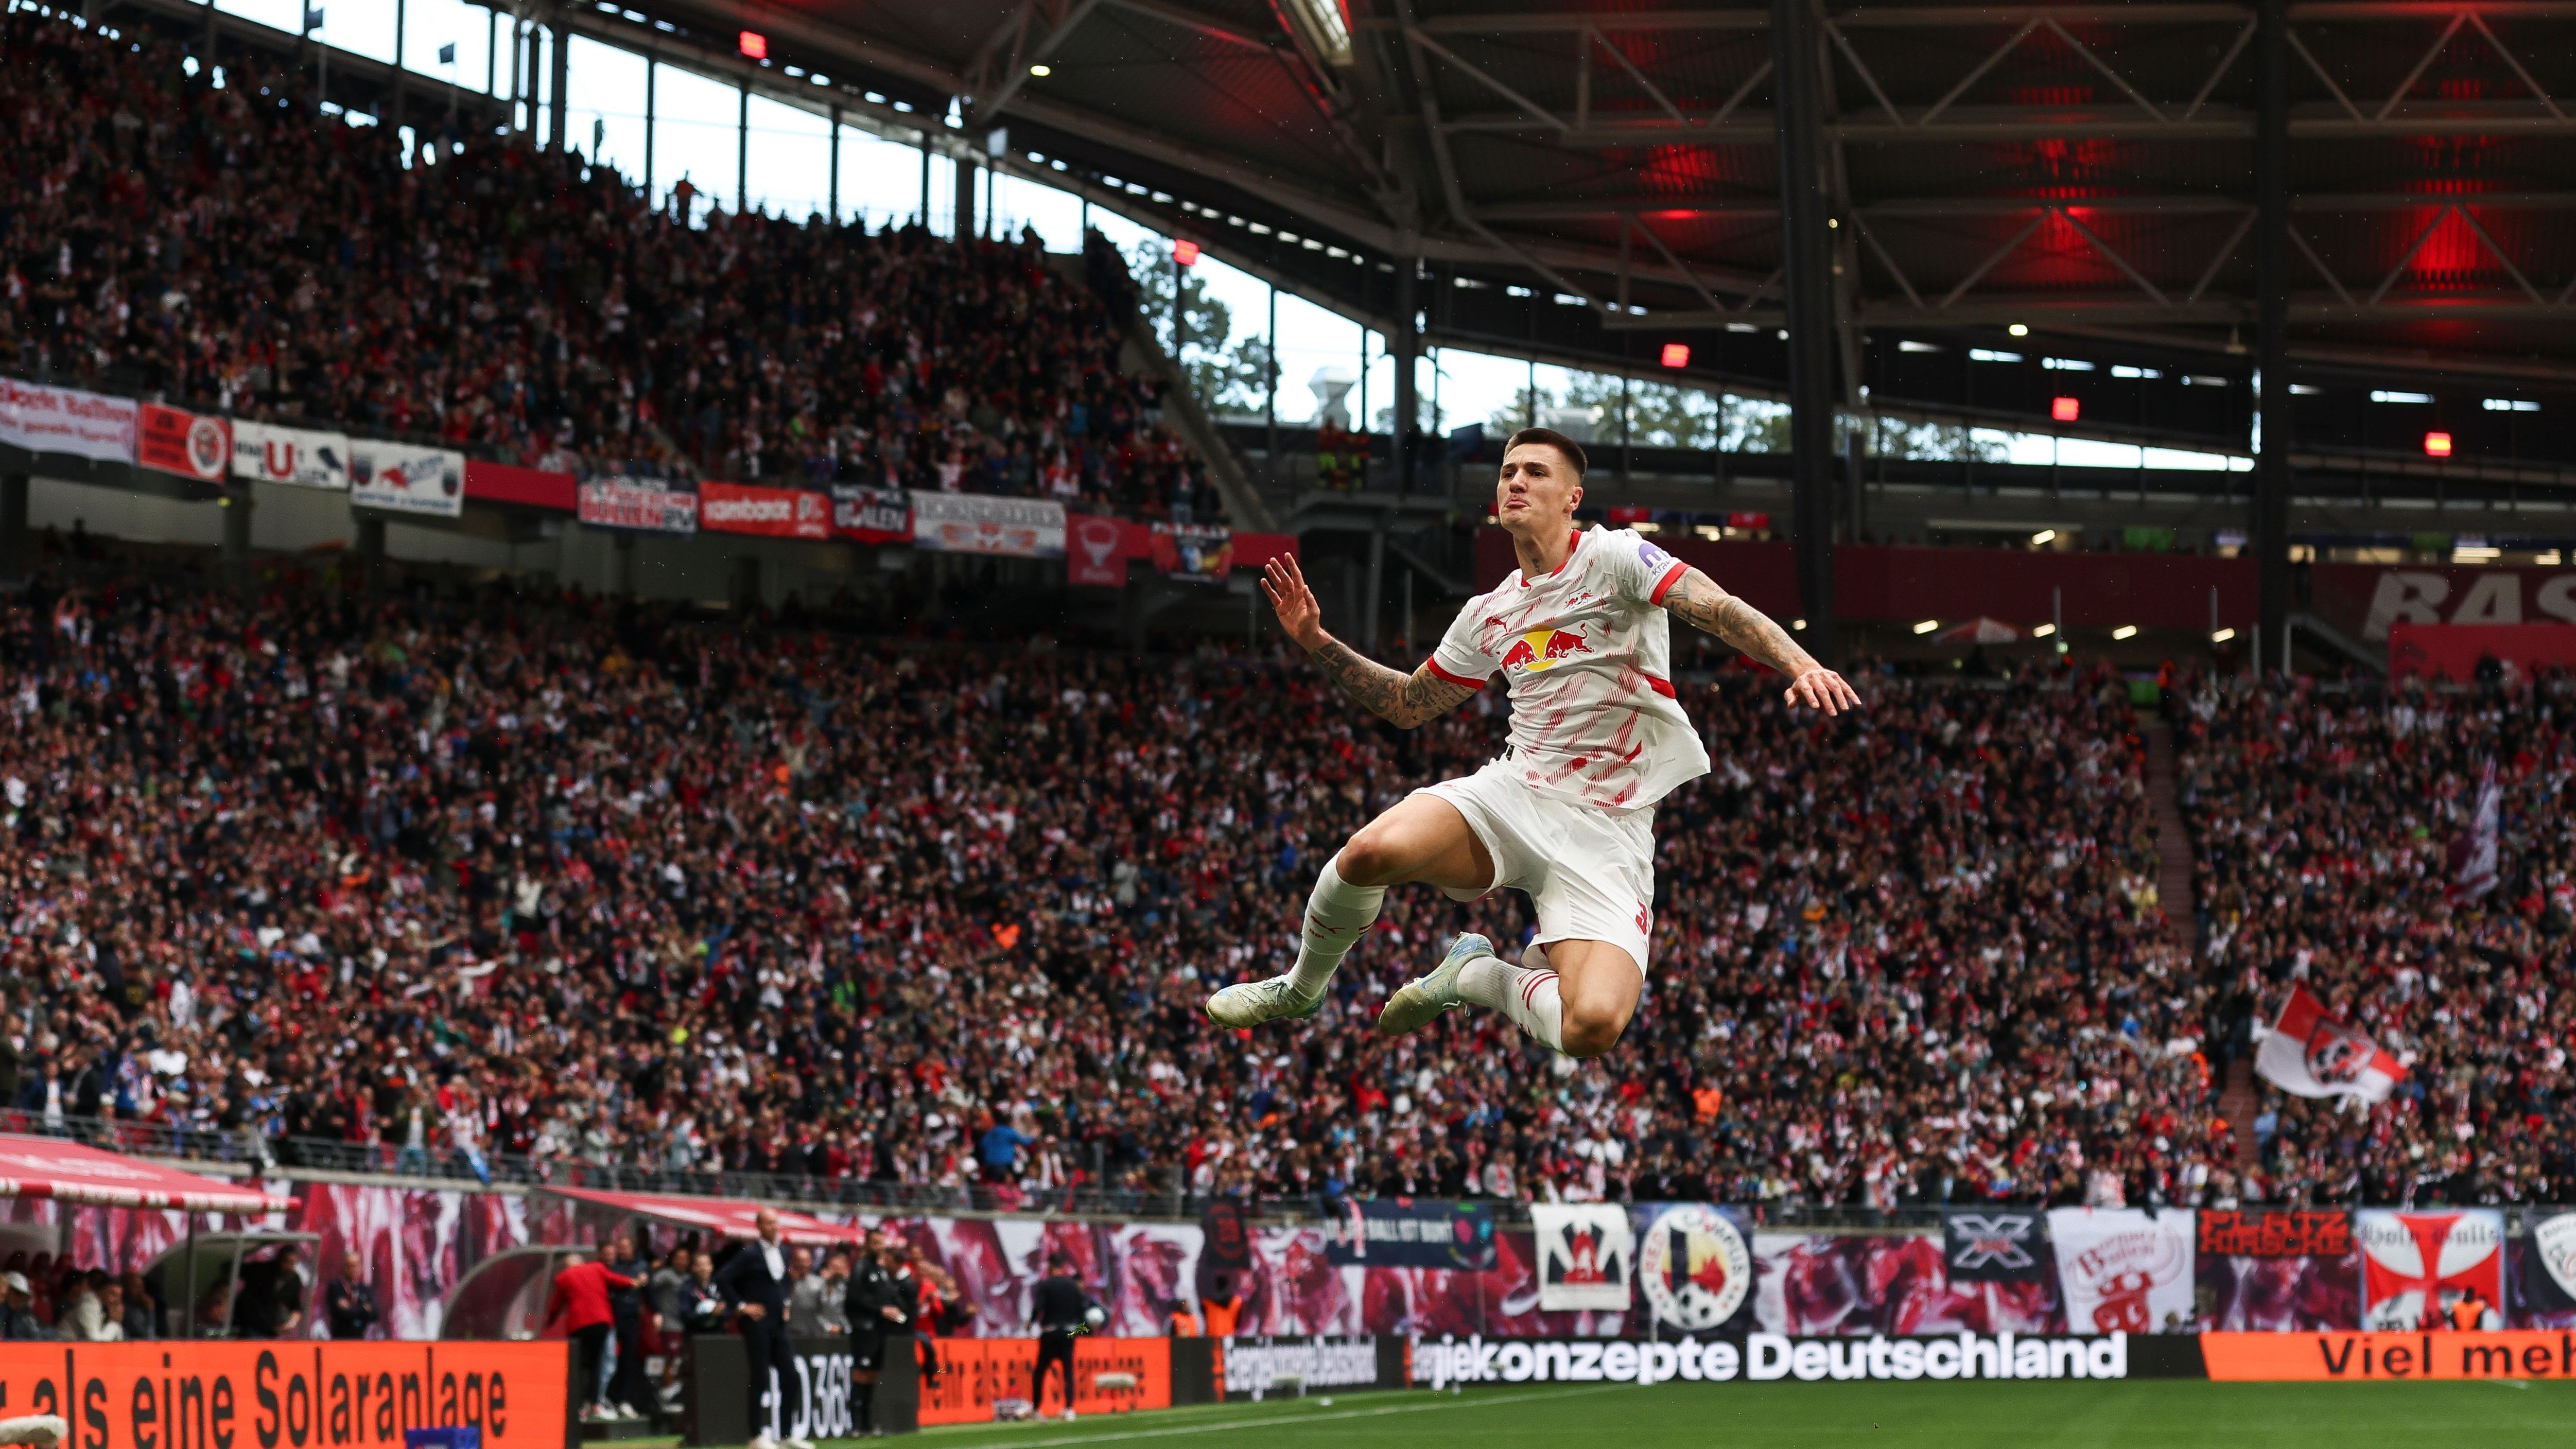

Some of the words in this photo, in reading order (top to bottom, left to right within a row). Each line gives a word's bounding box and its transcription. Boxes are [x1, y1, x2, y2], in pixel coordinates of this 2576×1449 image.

[1683, 1215, 1743, 1275] CMPUS
[1748, 1331, 2128, 1380] Deutschland
[2319, 1336, 2430, 1375] Viel
[132, 1352, 235, 1449] eine
[255, 1347, 506, 1449] Solaranlage
